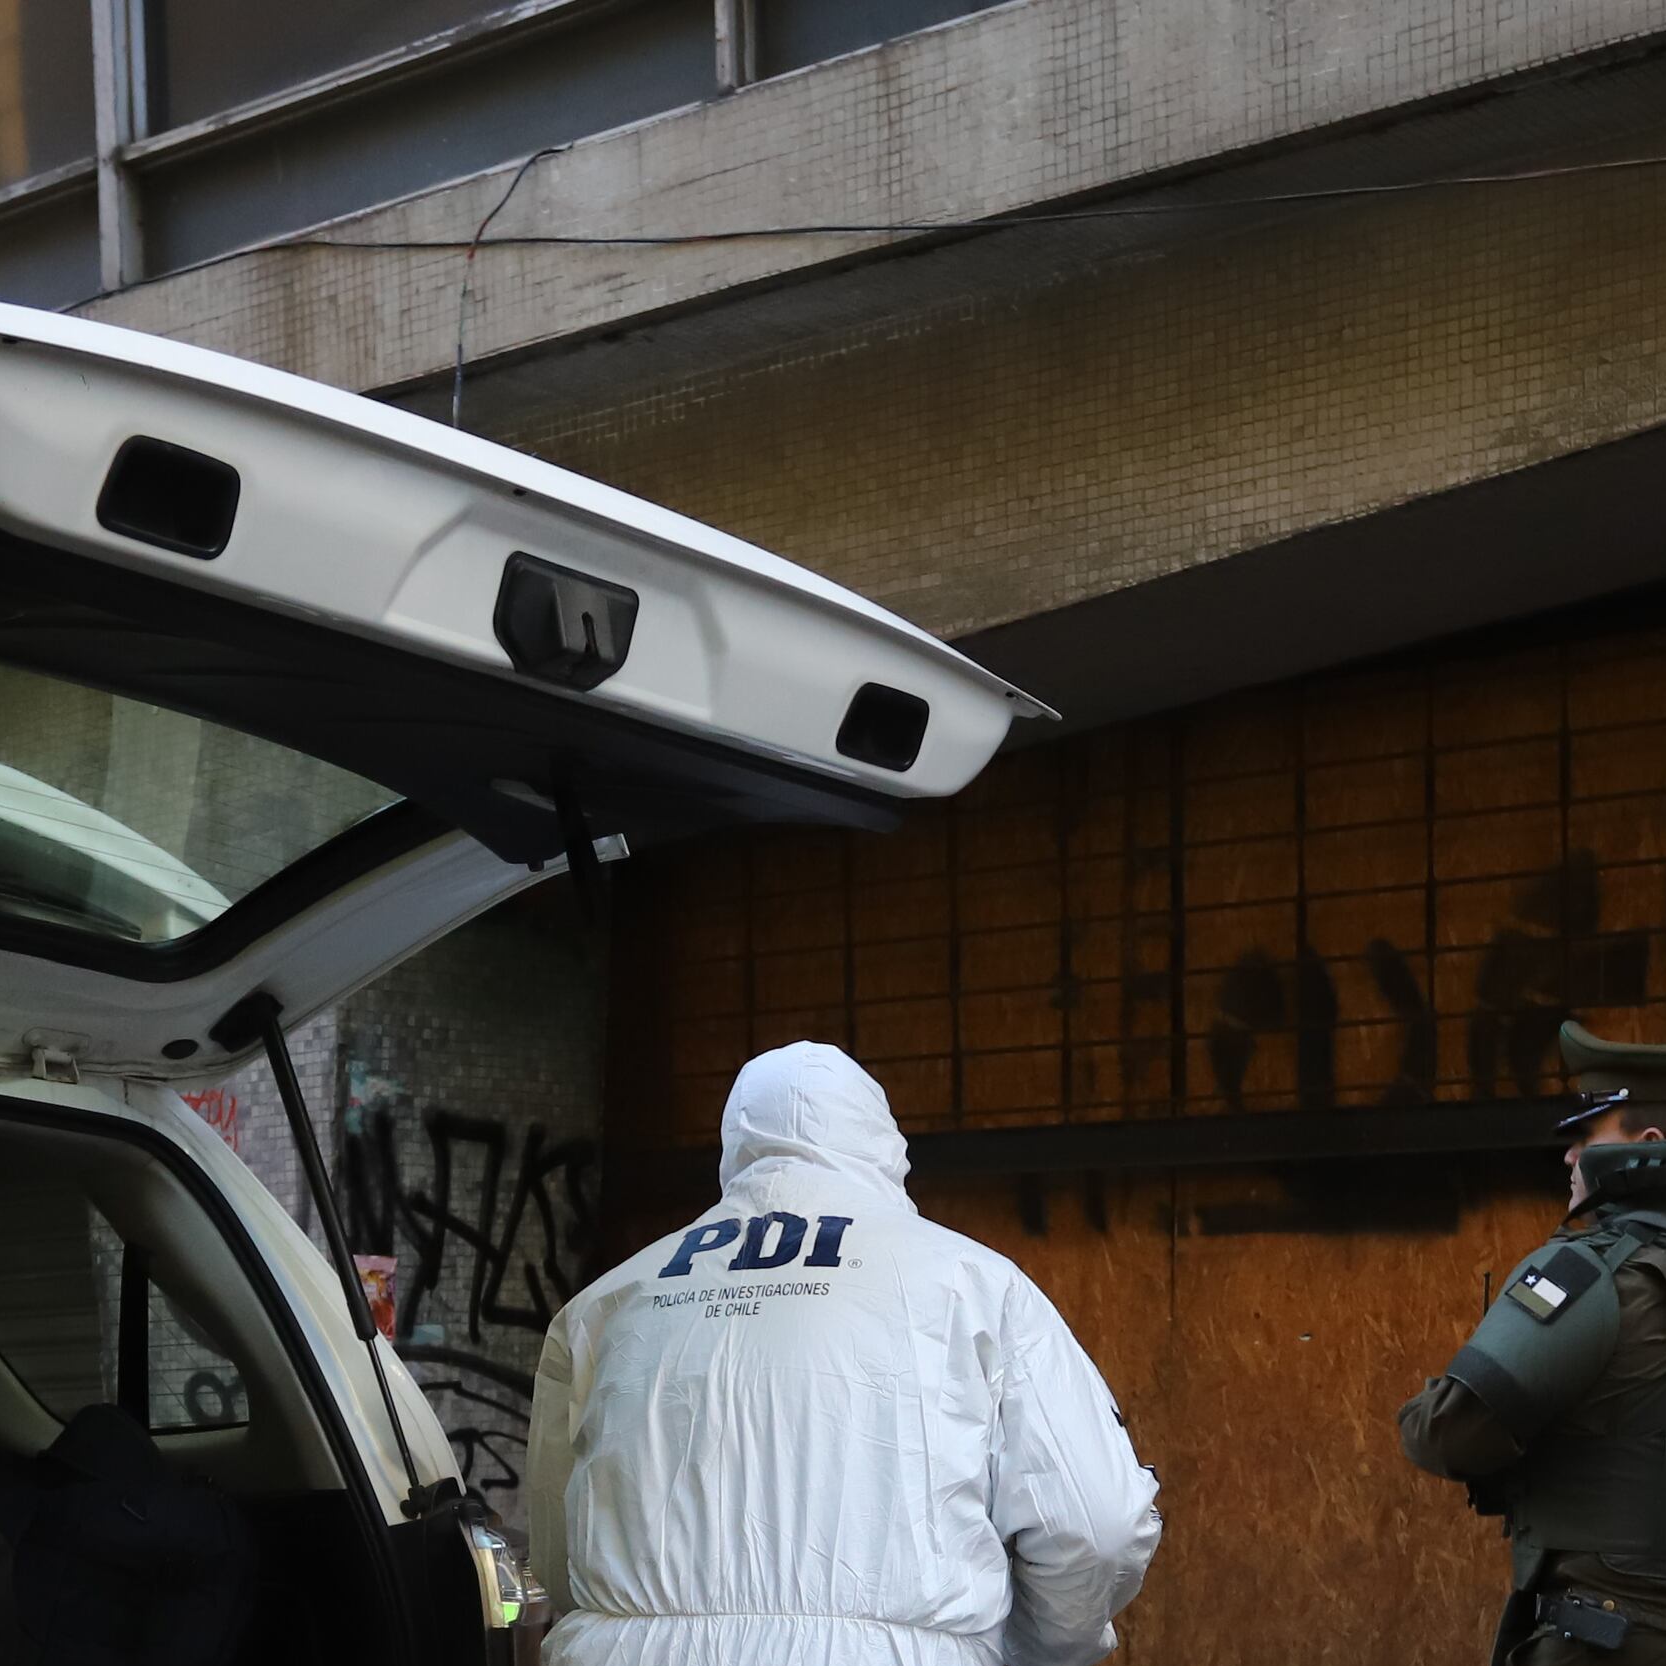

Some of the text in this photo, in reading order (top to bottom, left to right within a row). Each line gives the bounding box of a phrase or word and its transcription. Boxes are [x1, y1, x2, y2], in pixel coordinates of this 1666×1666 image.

[657, 1211, 854, 1278] PDI
[653, 1282, 830, 1310] POLICÍA DE INVESTIGACIONES
[705, 1301, 761, 1318] DE CHILE
